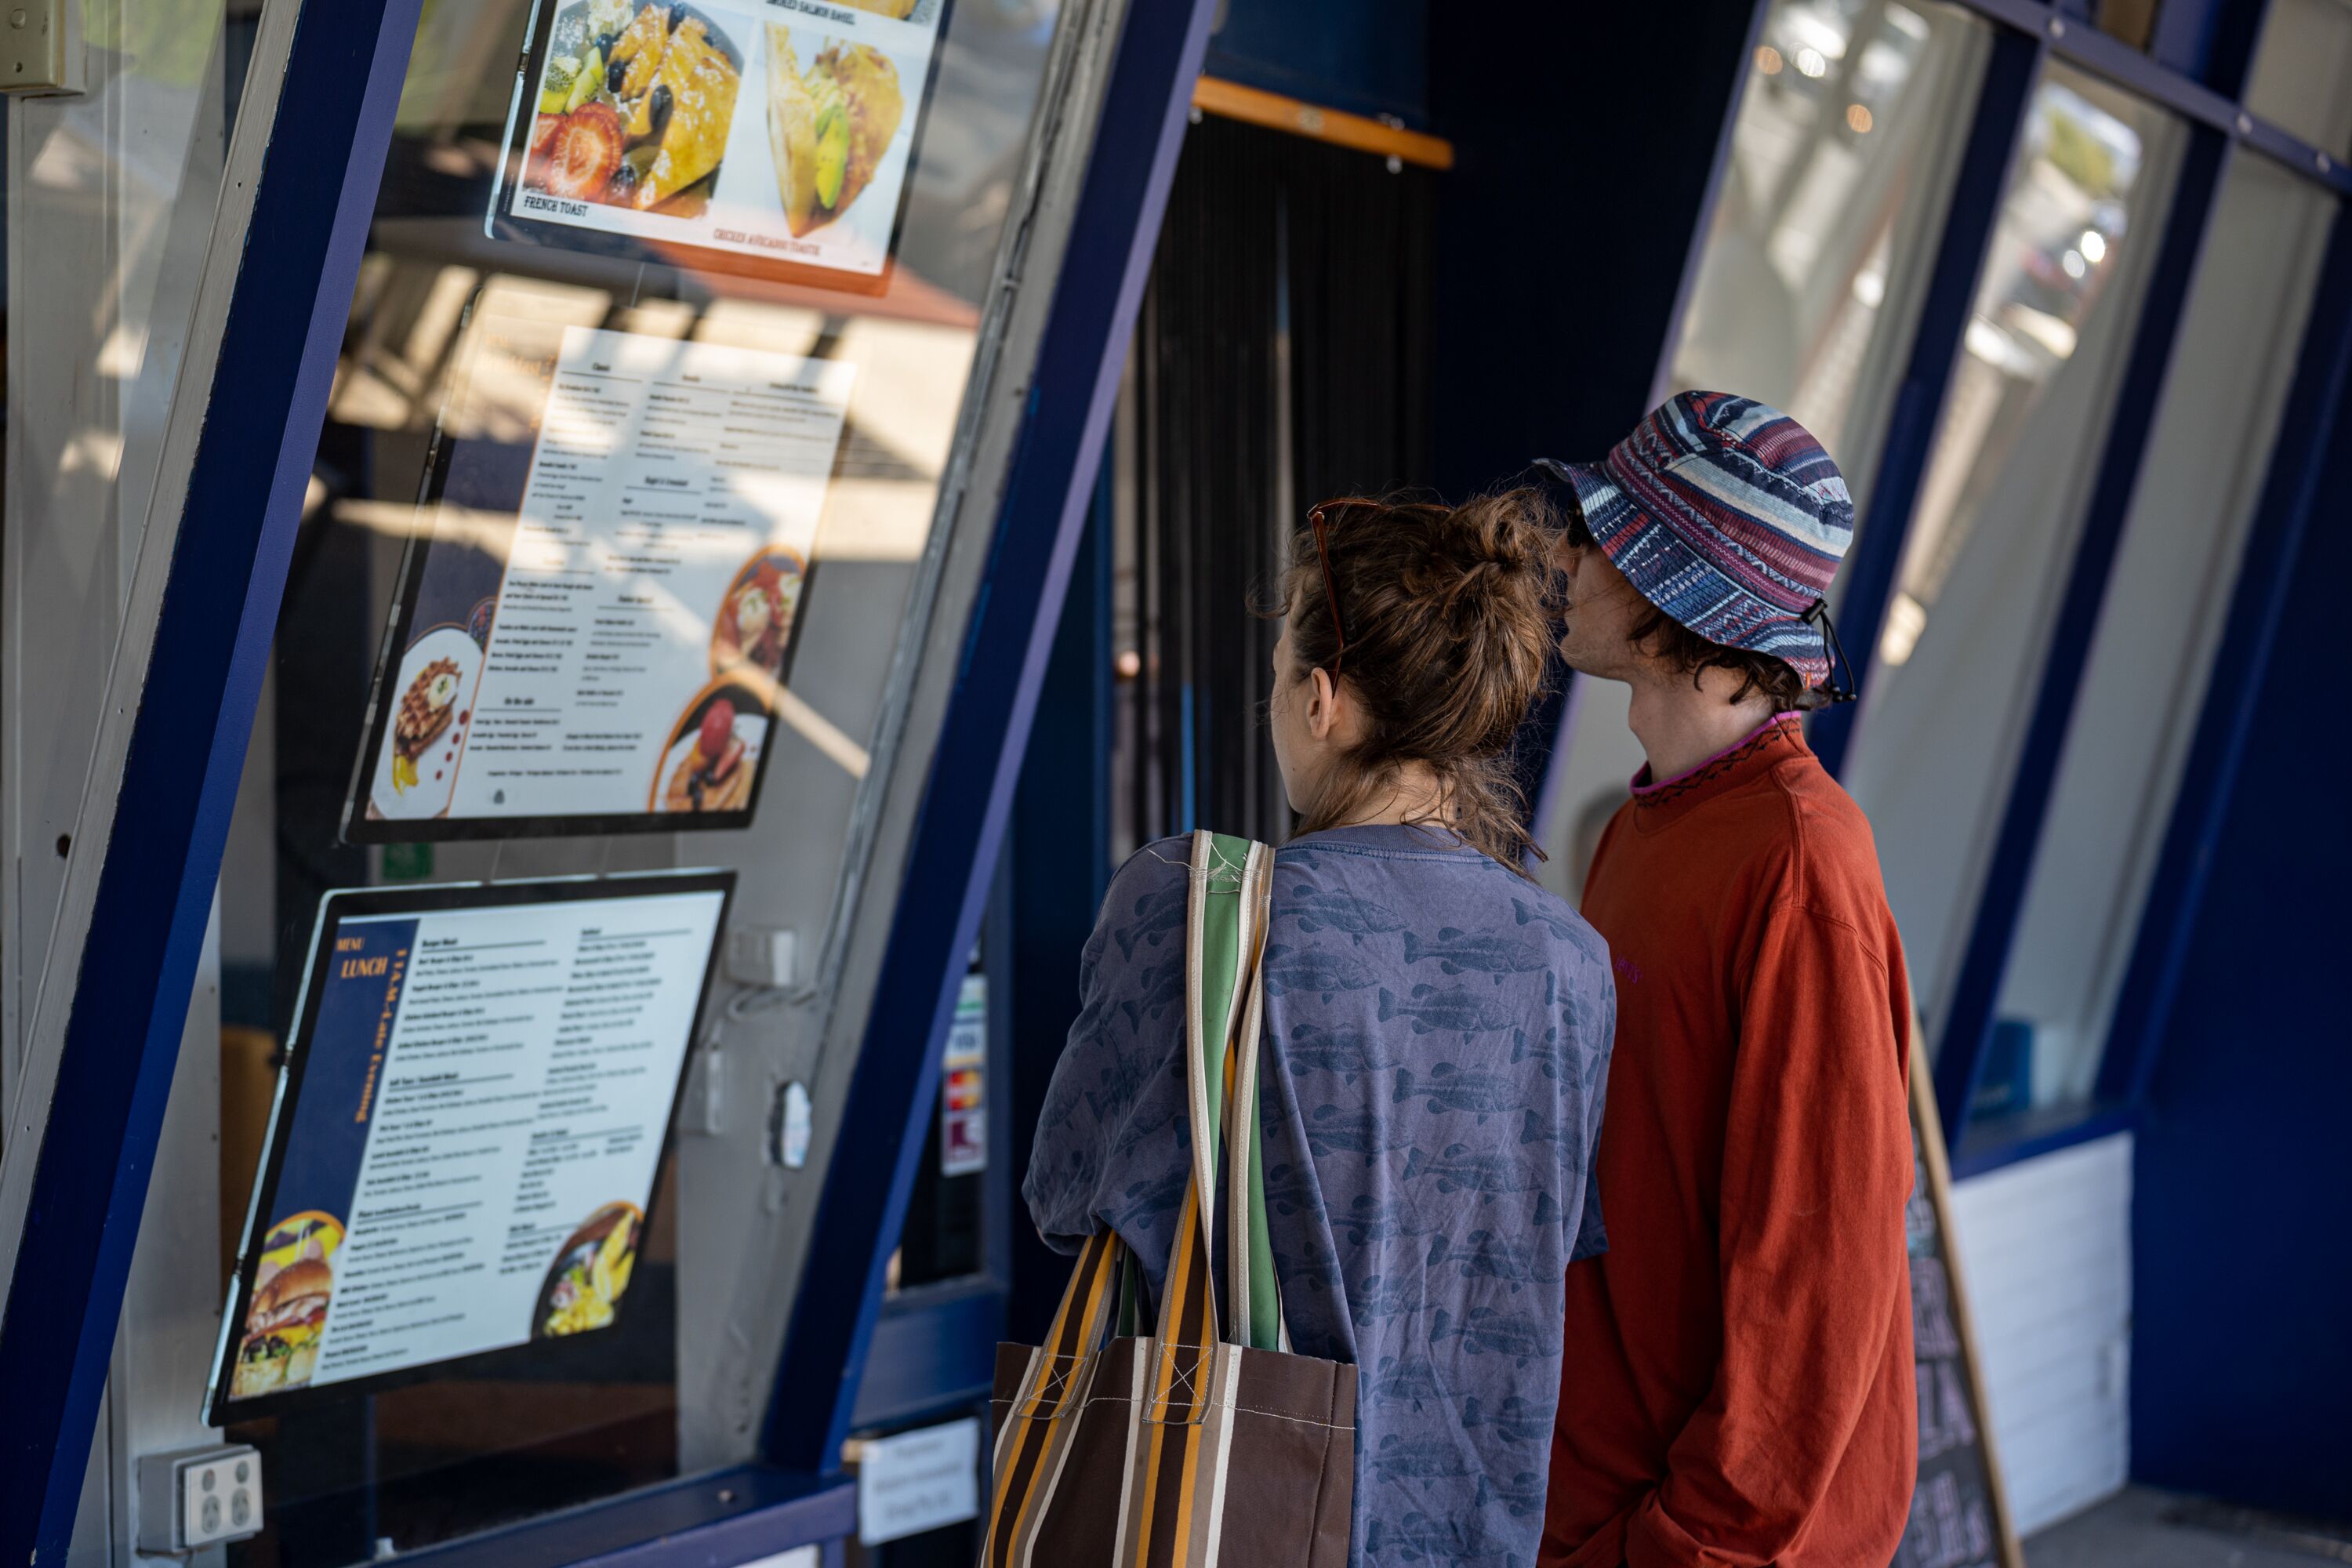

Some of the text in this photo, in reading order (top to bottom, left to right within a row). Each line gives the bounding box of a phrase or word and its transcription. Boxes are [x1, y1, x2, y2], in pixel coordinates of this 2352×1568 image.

[524, 195, 590, 217] FRENCH TOAST
[336, 938, 365, 953] MENU
[340, 956, 390, 979] LUNCH
